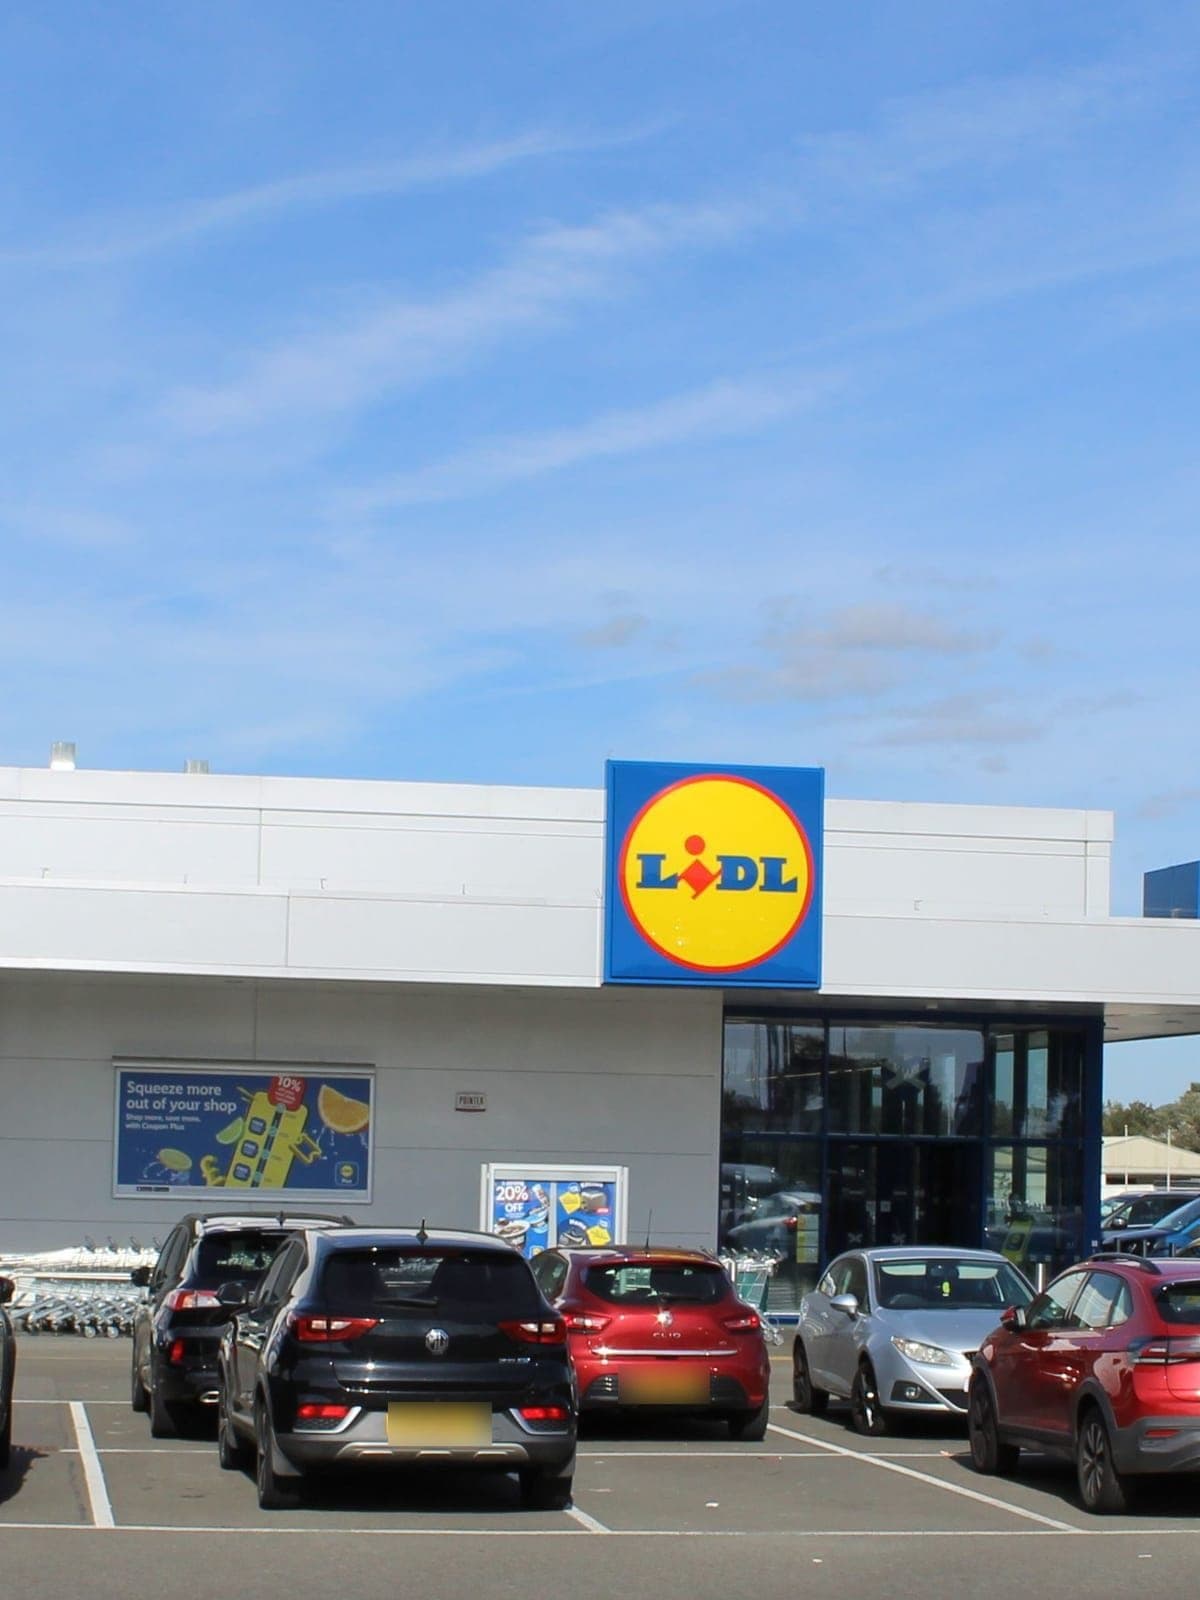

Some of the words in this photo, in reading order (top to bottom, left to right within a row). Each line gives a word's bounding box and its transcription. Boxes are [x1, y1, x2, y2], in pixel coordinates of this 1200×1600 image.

[127, 1081, 183, 1097] Squeeze
[187, 1085, 222, 1096] more
[278, 1075, 301, 1092] 10%
[126, 1099, 149, 1110] out
[153, 1098, 167, 1110] of
[169, 1101, 200, 1113] your
[204, 1099, 237, 1115] shop
[496, 1185, 529, 1201] 20%
[505, 1203, 524, 1213] OFF
